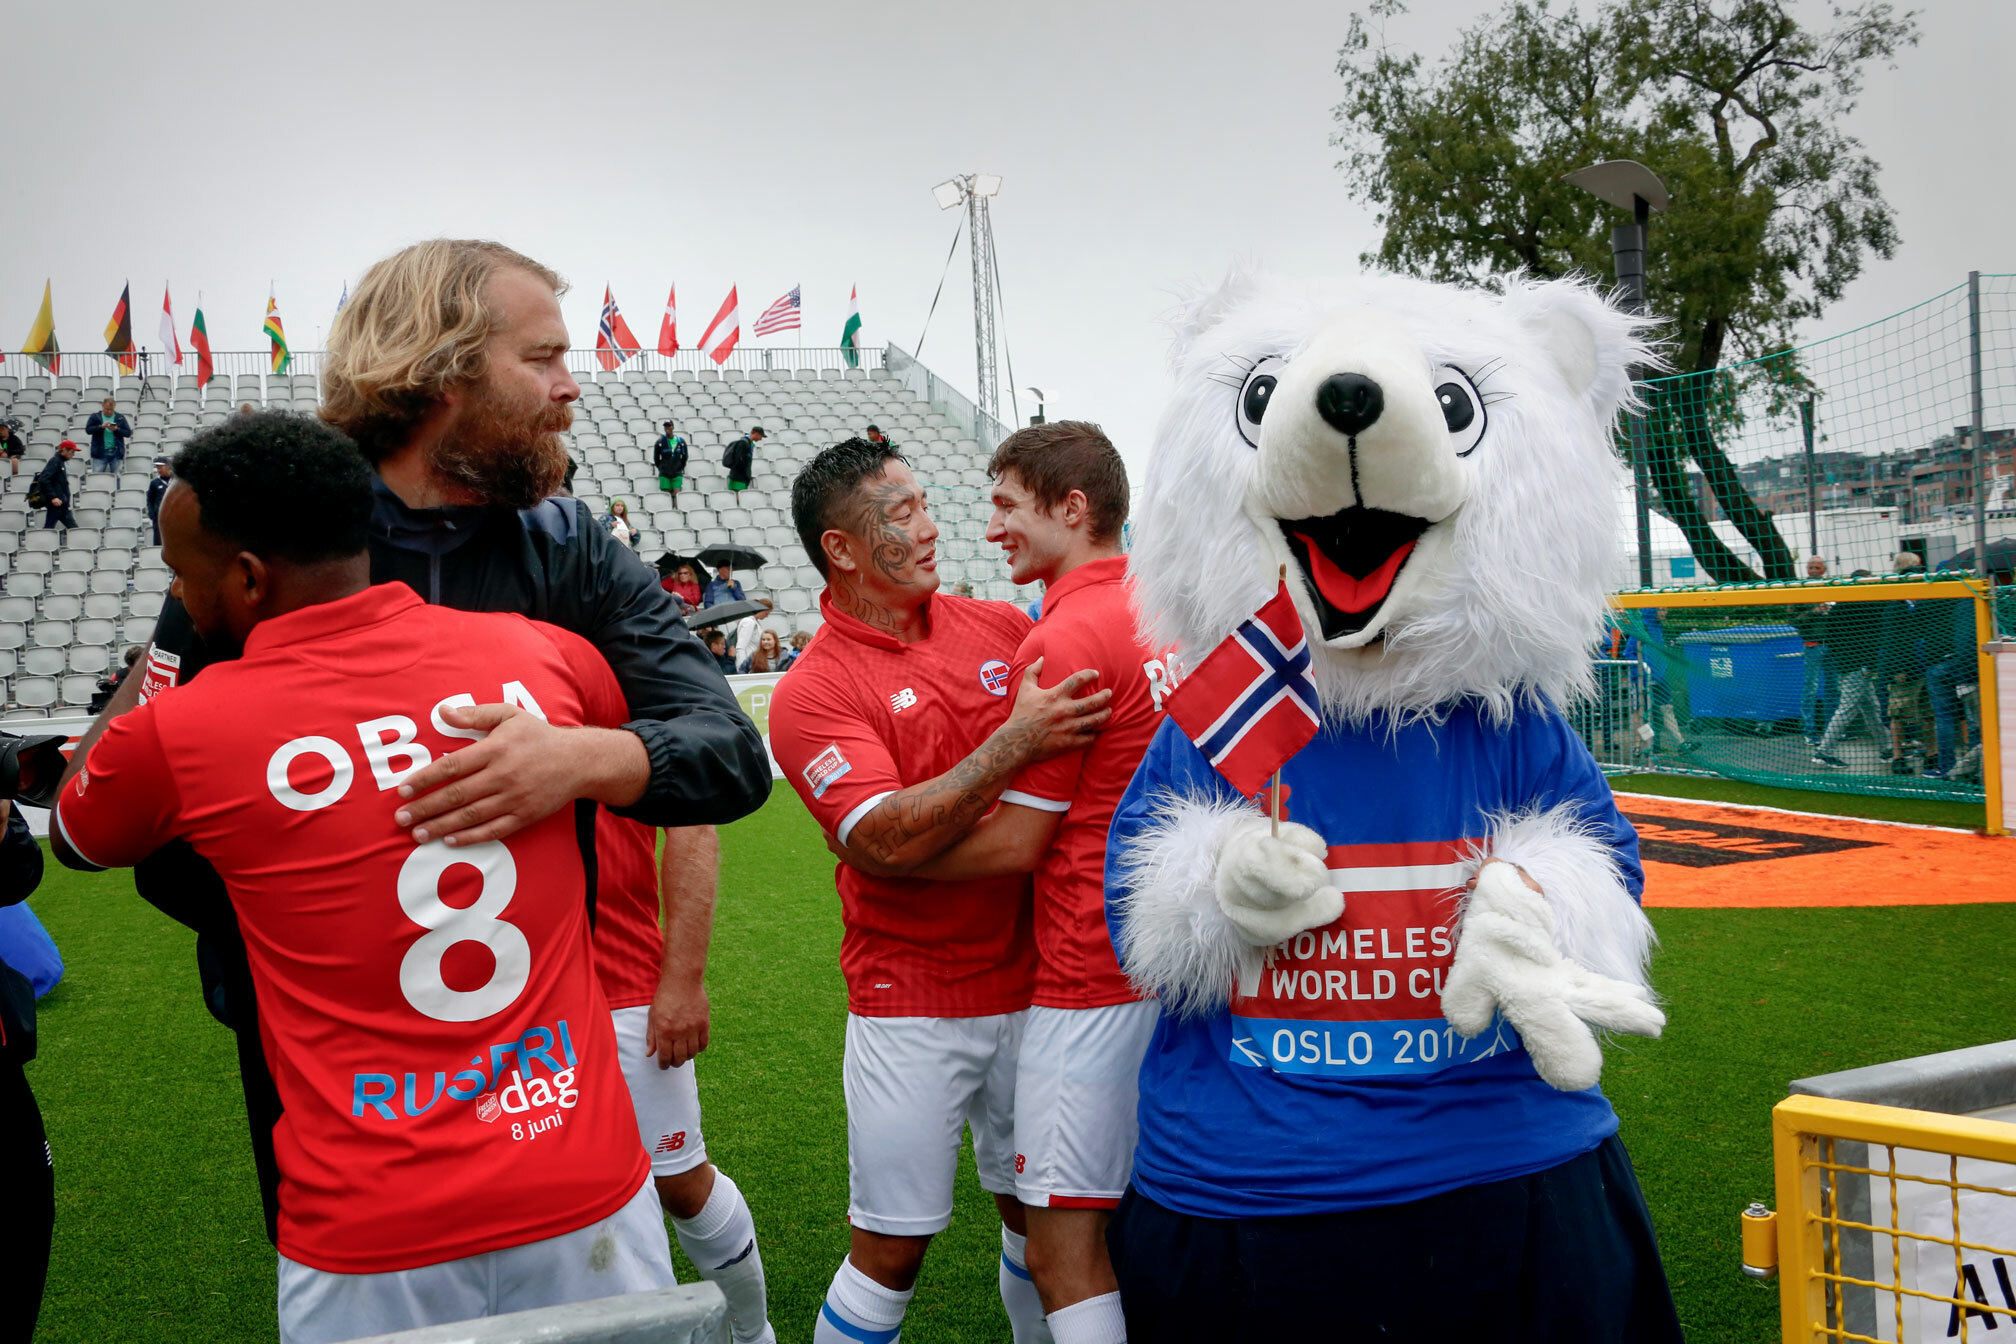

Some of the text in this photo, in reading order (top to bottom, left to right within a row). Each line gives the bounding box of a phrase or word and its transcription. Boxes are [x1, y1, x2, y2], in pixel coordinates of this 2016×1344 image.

[397, 839, 531, 1022] 8
[1272, 967, 1453, 1000] WORLD CU
[1272, 1029, 1373, 1065] OSLO
[352, 1020, 578, 1120] RUSFRI
[500, 1066, 579, 1113] dag
[511, 1109, 563, 1141] 8 juni
